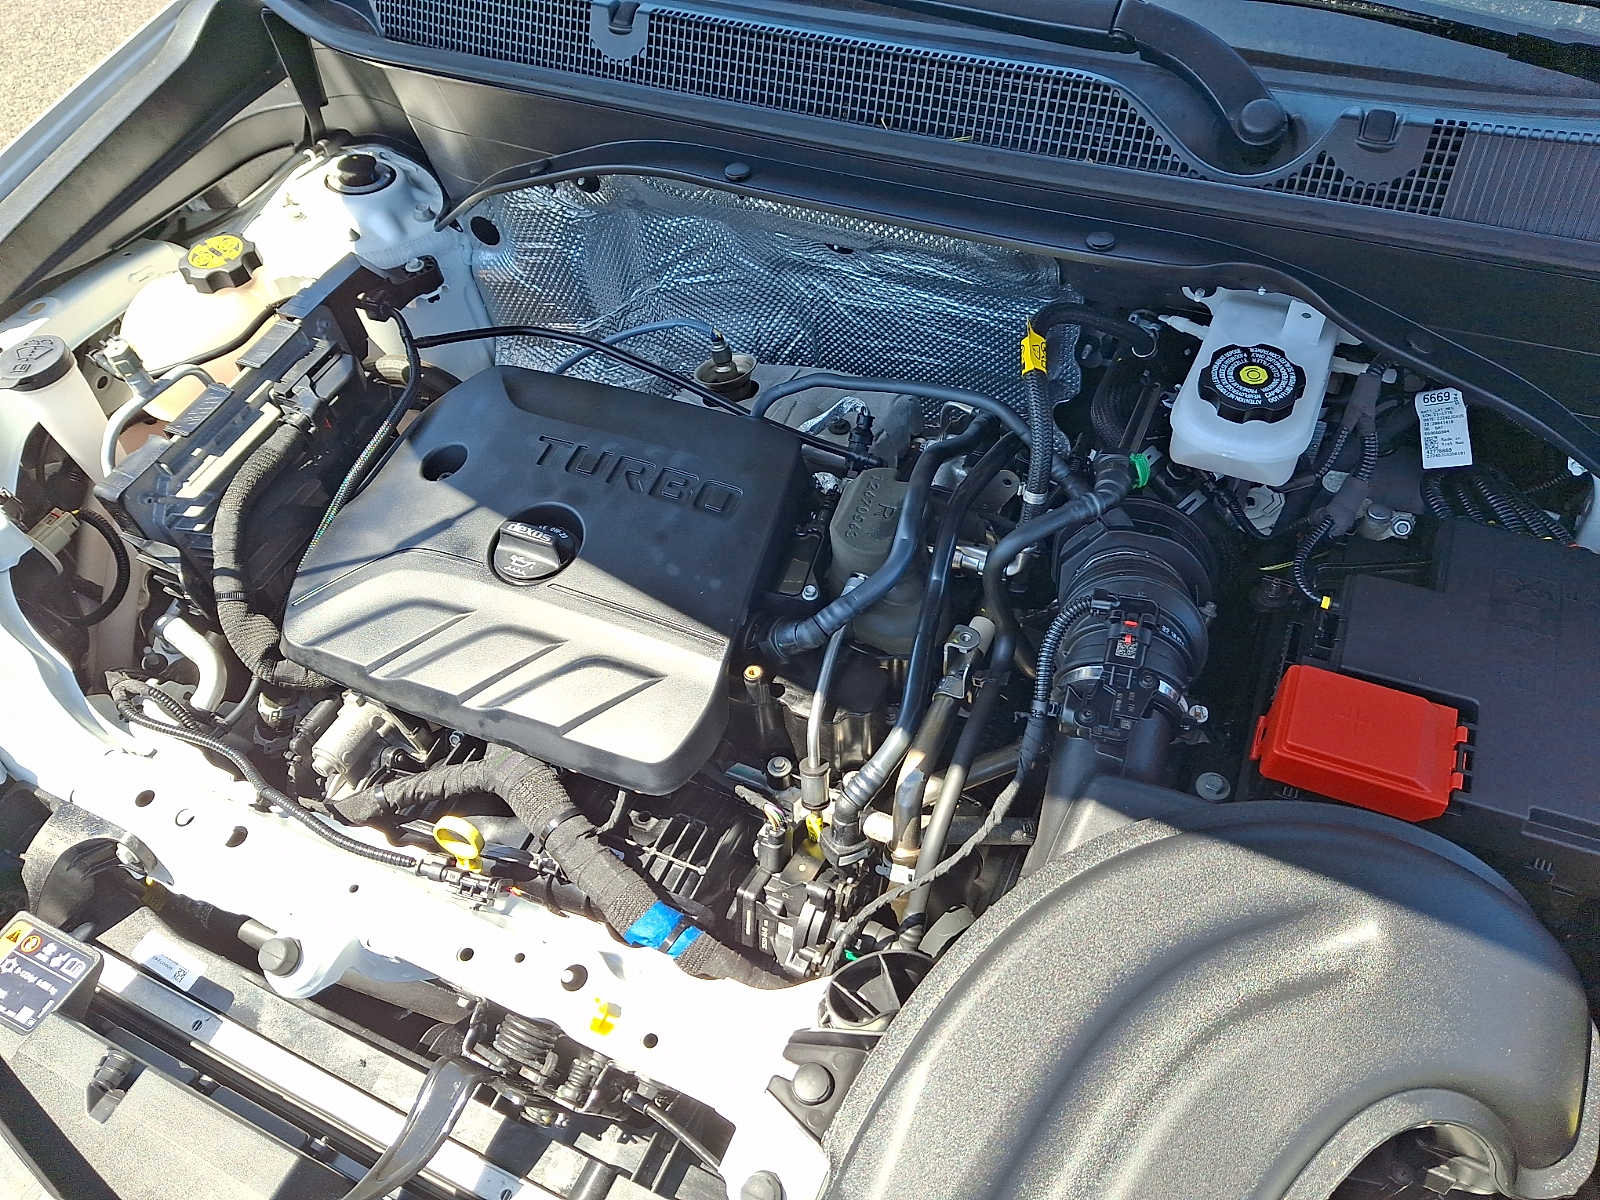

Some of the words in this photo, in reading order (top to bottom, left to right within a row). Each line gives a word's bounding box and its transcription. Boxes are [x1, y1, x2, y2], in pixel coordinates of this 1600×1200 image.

[1423, 391, 1450, 403] 6669
[535, 433, 744, 516] TURBO
[507, 522, 553, 542] dexos
